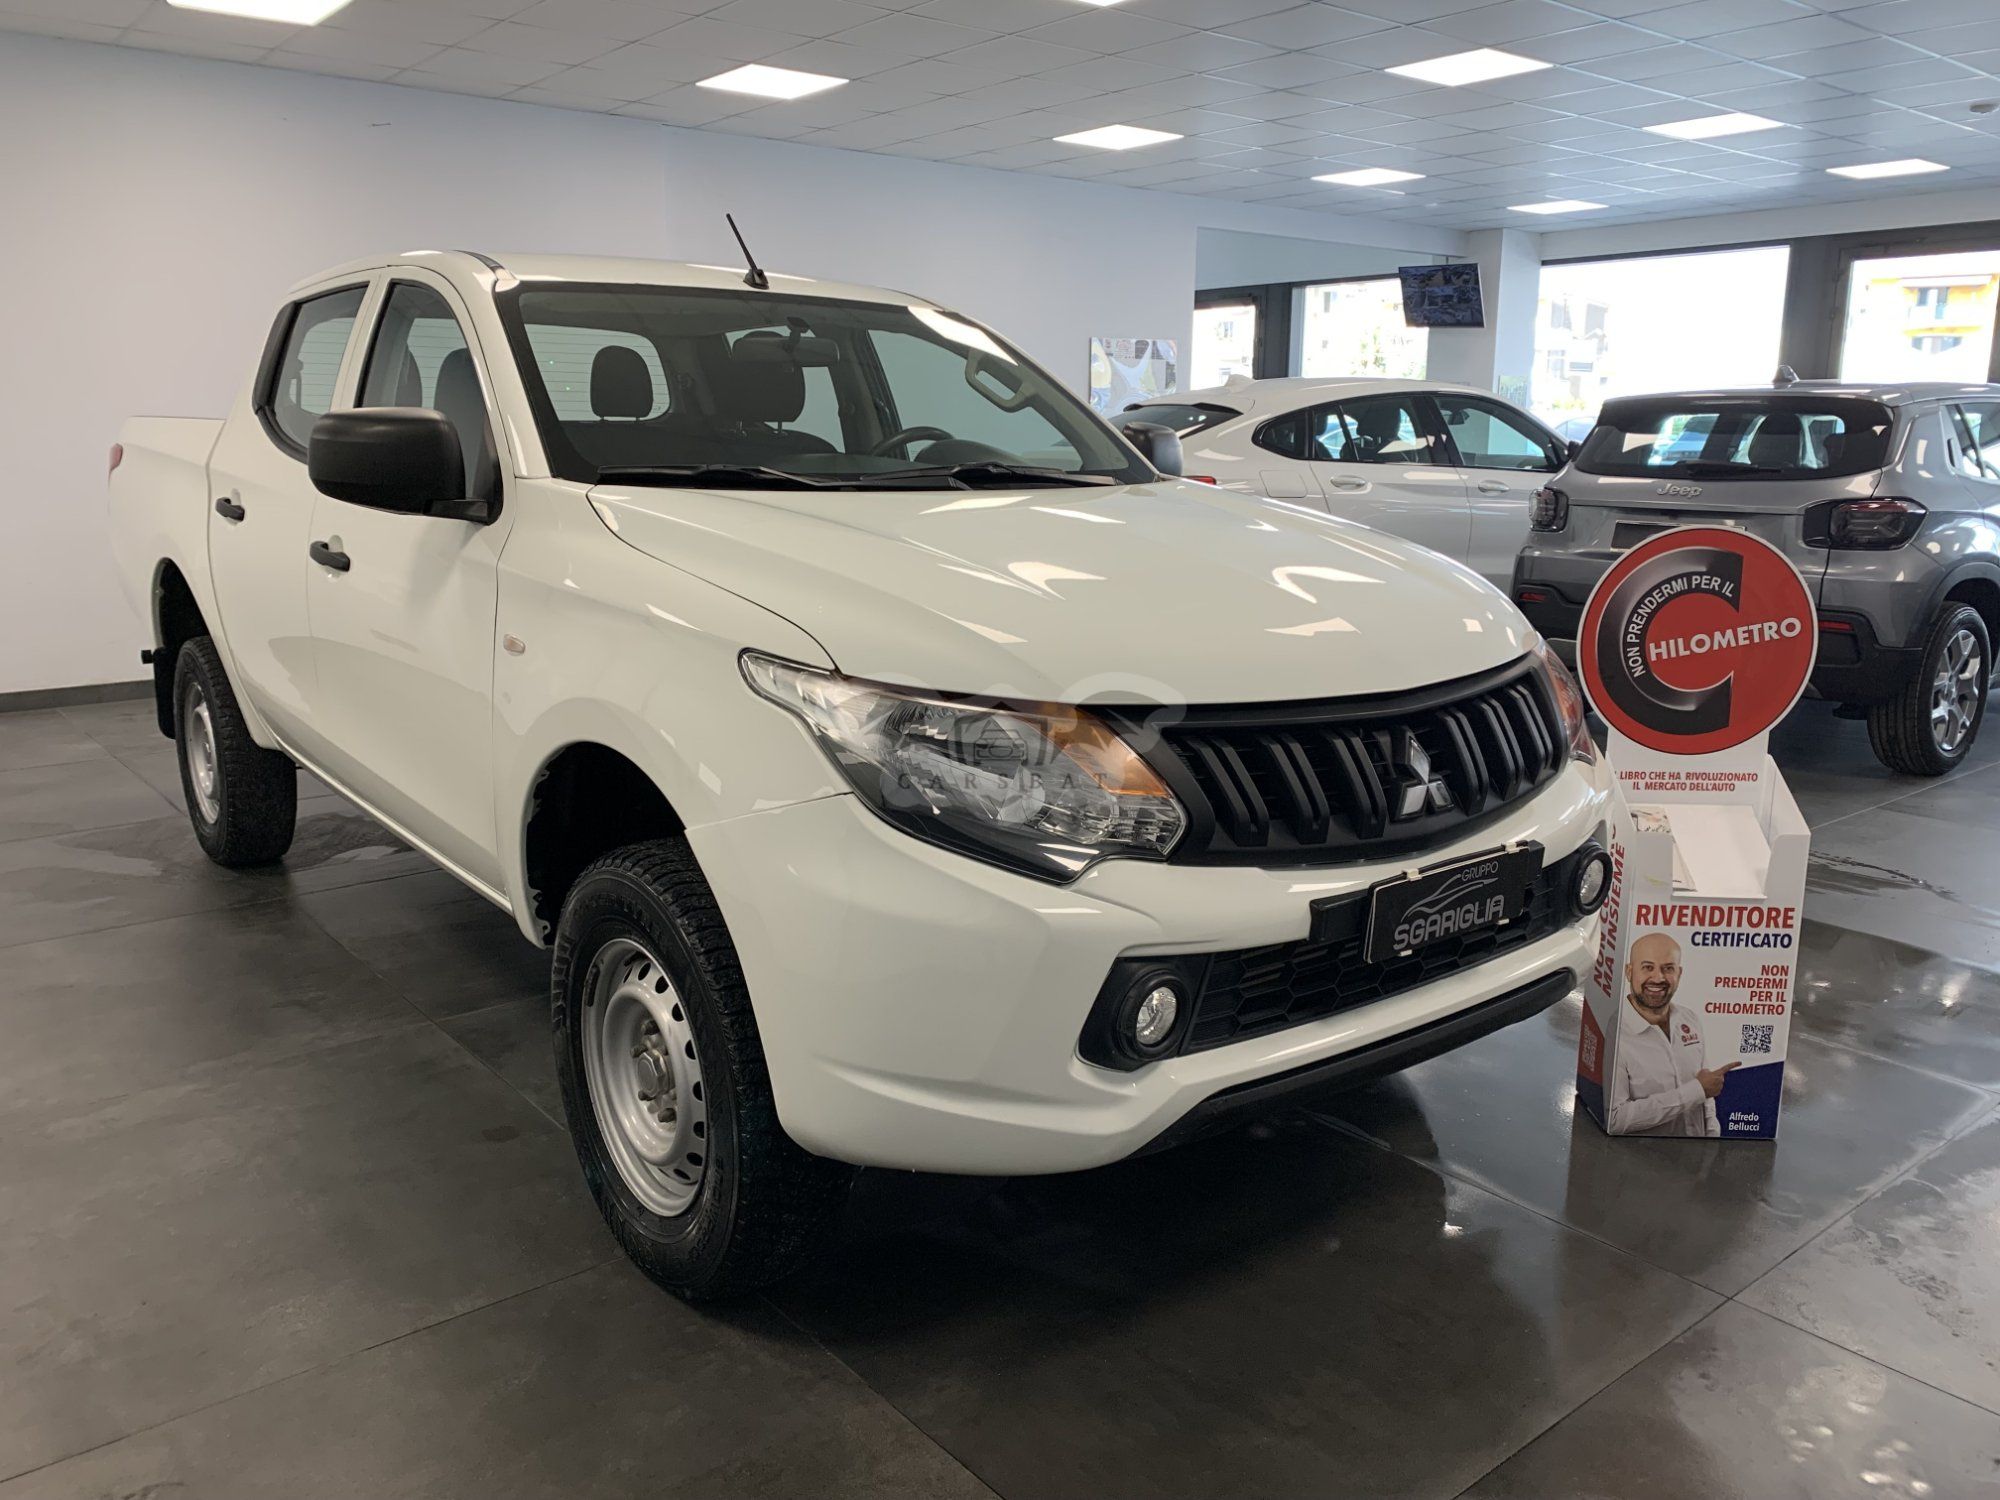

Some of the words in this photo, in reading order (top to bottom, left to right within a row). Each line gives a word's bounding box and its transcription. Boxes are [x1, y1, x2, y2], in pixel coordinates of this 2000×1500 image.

[1656, 483, 1702, 499] Jeep
[1691, 575, 1719, 590] PER
[1722, 582, 1735, 598] IL
[1626, 576, 1688, 643] PRENDERMI
[1628, 647, 1645, 678] NON
[1620, 771, 1646, 780] LIBRO
[1649, 771, 1666, 780] CHE
[1668, 772, 1681, 780] HA
[1685, 772, 1758, 782] RIVOLUZIONATO
[1632, 782, 1641, 790] IL
[1644, 782, 1687, 791] MERCATO
[1689, 782, 1736, 792] DELL'AUTO
[1461, 860, 1499, 881] GRUPPO
[1607, 842, 1625, 951] INSIEME
[1393, 894, 1505, 951] SGARIGLIA
[1636, 903, 1796, 929] RIVENDITORE
[1691, 931, 1793, 948] CERTIFICATO
[1602, 957, 1614, 998] MA
[1761, 965, 1789, 977] NON
[1714, 976, 1788, 990] PRENDERMI
[1749, 990, 1773, 1002] PER
[1776, 990, 1787, 1002] IL
[1705, 1002, 1785, 1015] CHILOMETRO
[1728, 1112, 1759, 1122] Alfredo
[1728, 1121, 1760, 1132] Bellucci
